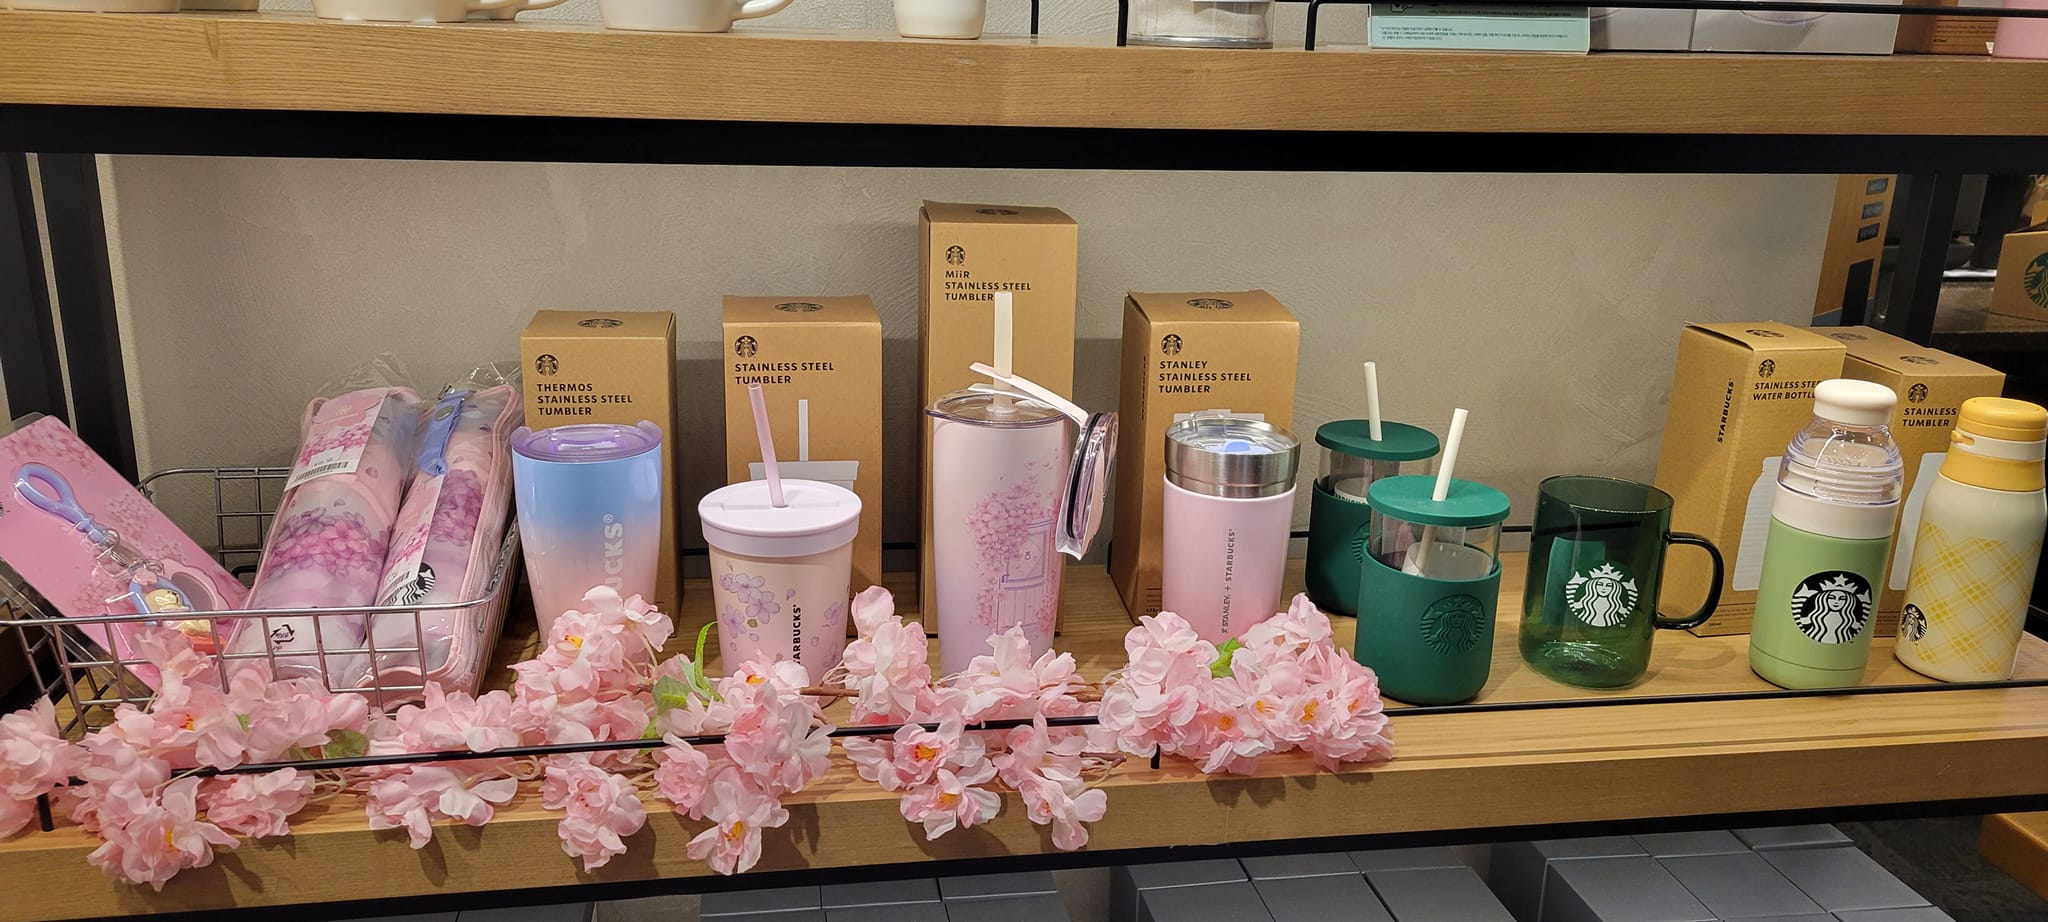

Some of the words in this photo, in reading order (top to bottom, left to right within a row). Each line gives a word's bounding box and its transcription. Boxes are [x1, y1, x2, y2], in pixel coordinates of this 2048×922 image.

[945, 270, 970, 279] MiiR
[945, 281, 1000, 290] STAINLESS
[1002, 282, 1032, 291] STEEL
[944, 292, 994, 301] TUMBLER
[735, 363, 798, 372] STAINLESS
[801, 362, 835, 371] STEEL
[1159, 360, 1208, 369] STANLEY
[735, 375, 792, 385] TUMBLER
[1159, 373, 1217, 382] STAINLESS
[1220, 372, 1252, 381] STEEL
[536, 383, 593, 392] THERMOS
[1158, 385, 1211, 394] TUMBLER
[1754, 381, 1800, 390] STAINLESS
[1801, 380, 1821, 389] STE
[537, 395, 598, 404] STAINLESS
[600, 394, 633, 403] STEEL
[1753, 392, 1783, 401] WATER
[538, 406, 592, 416] TUMBLER
[1717, 380, 1735, 444] STARBUCKS
[1903, 407, 1958, 416] STAINLESS
[1902, 418, 1950, 427] TUMBLER
[792, 606, 801, 664] ARBUCKS
